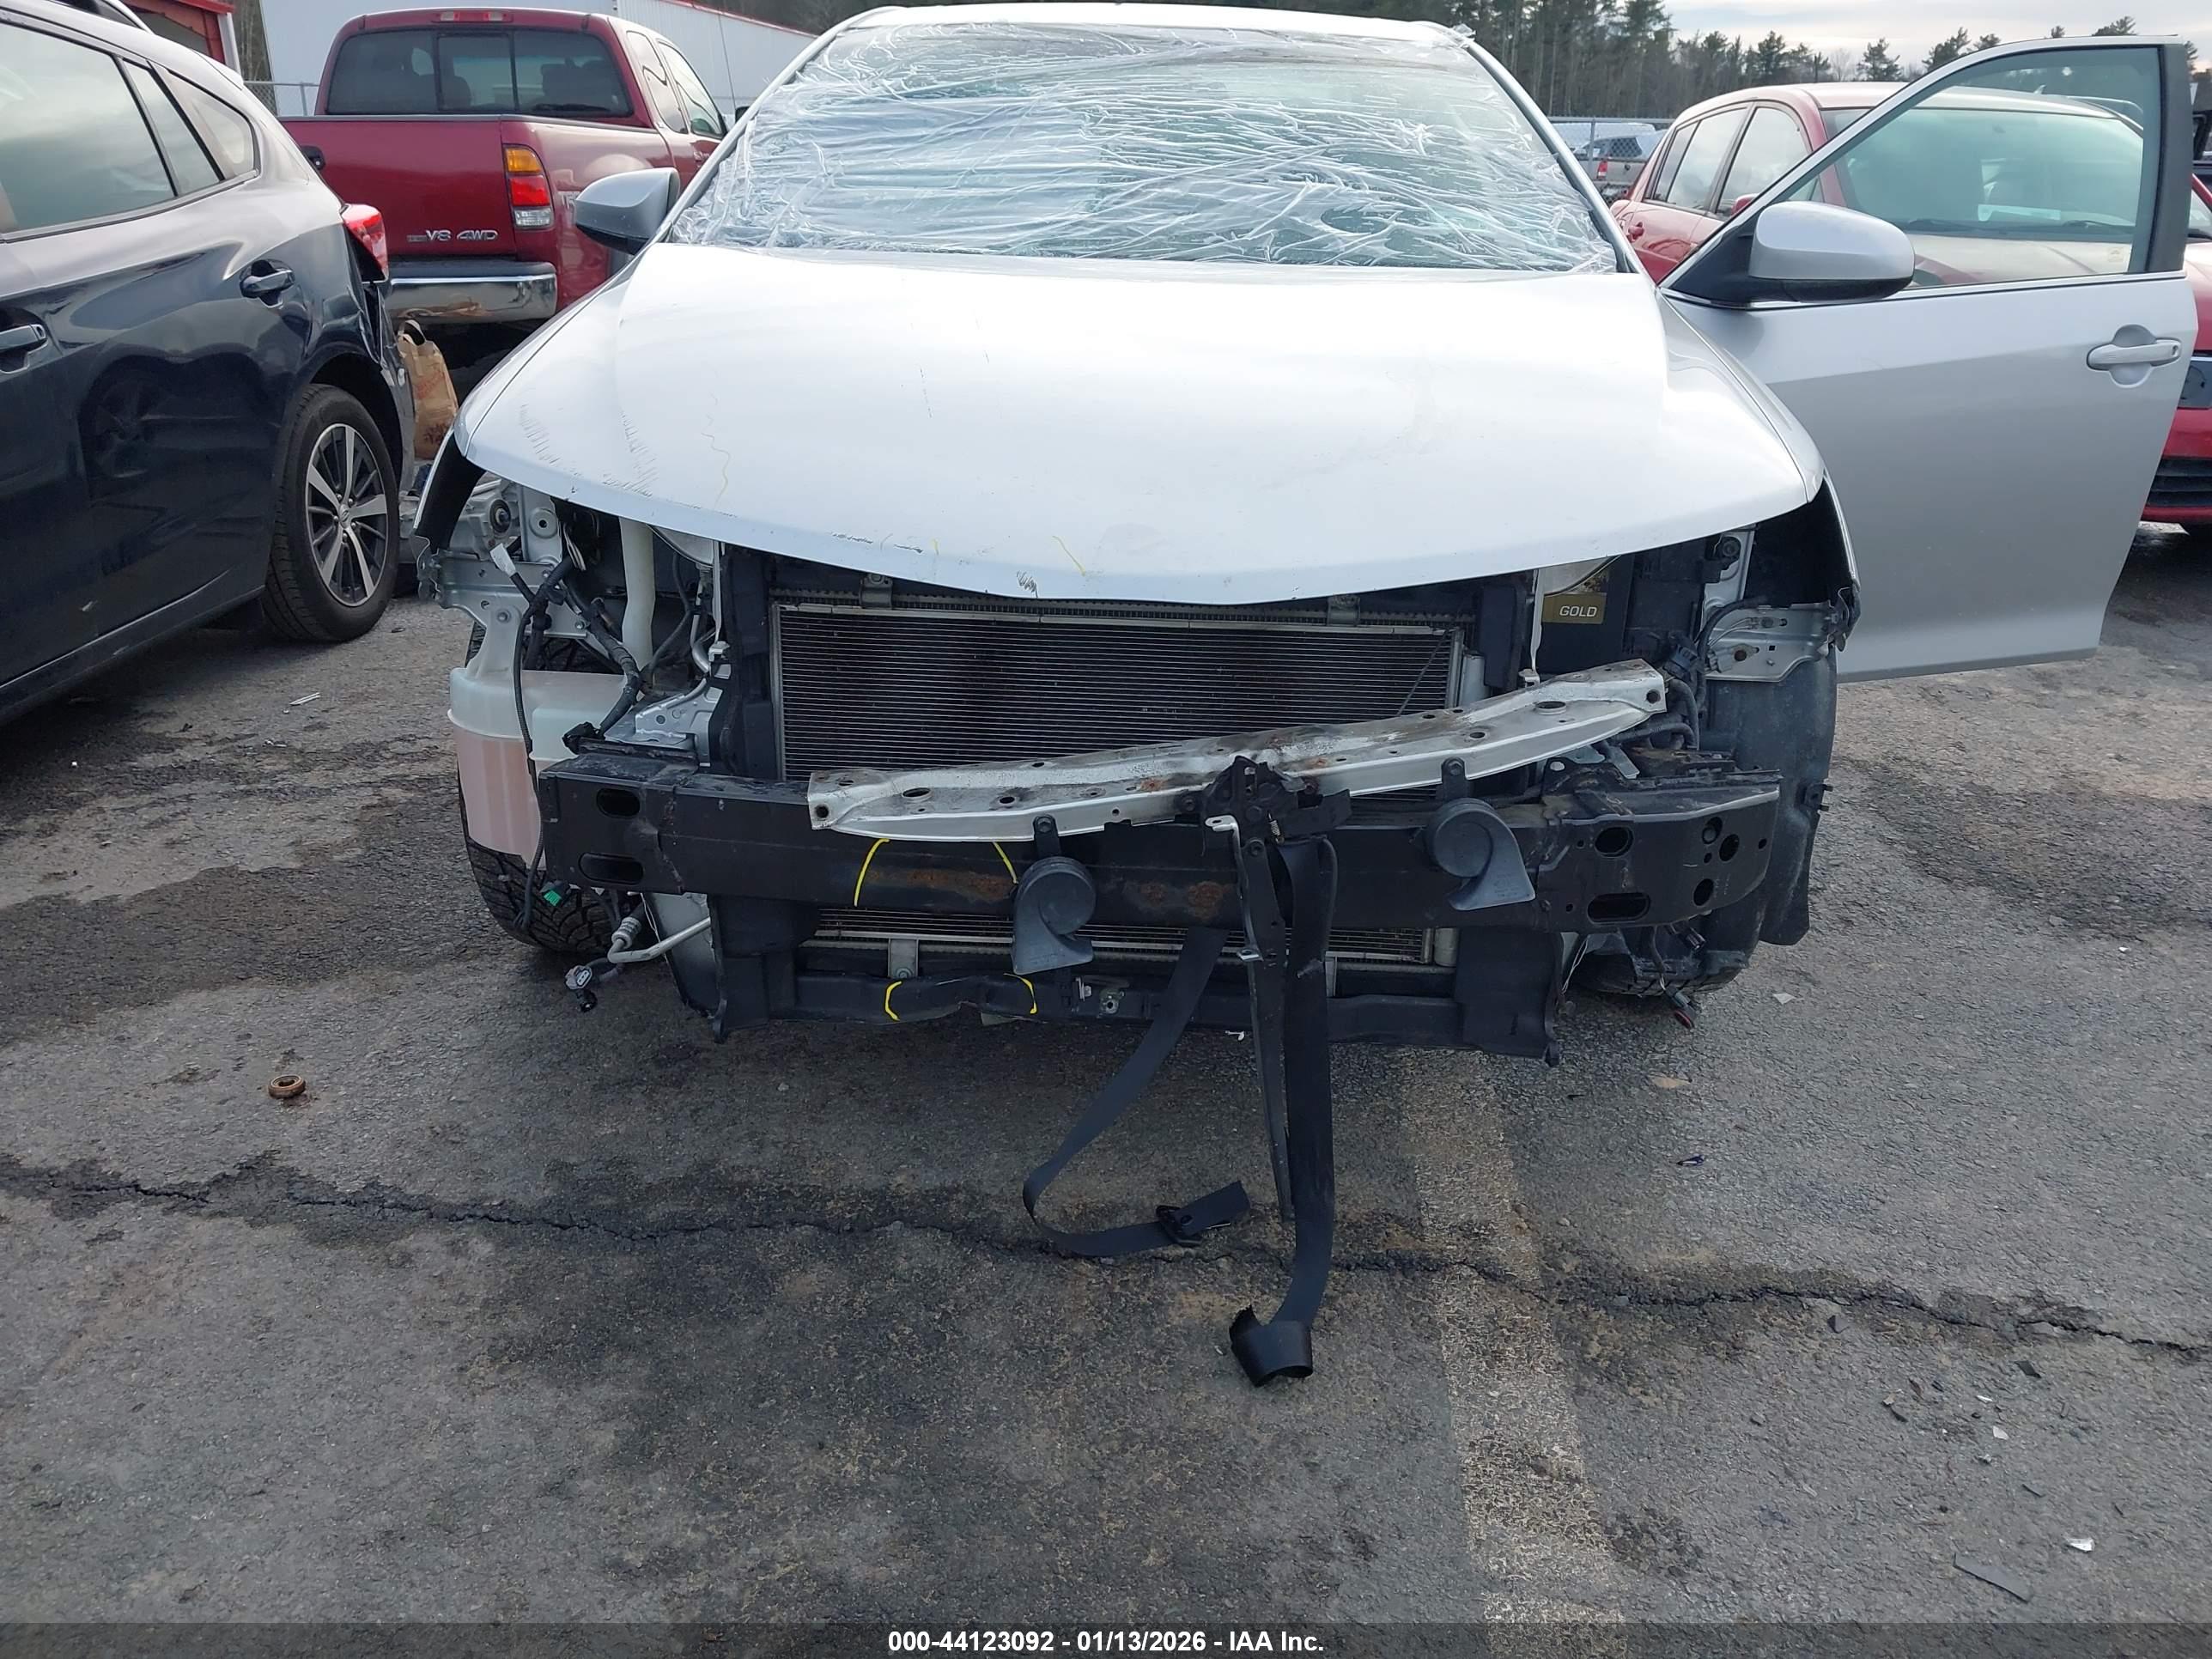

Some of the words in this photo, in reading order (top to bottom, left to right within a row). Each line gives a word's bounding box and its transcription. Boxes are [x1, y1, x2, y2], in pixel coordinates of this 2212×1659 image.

[426, 229, 452, 241] V8
[456, 229, 498, 240] 4WD
[1559, 605, 1597, 617] GOLD
